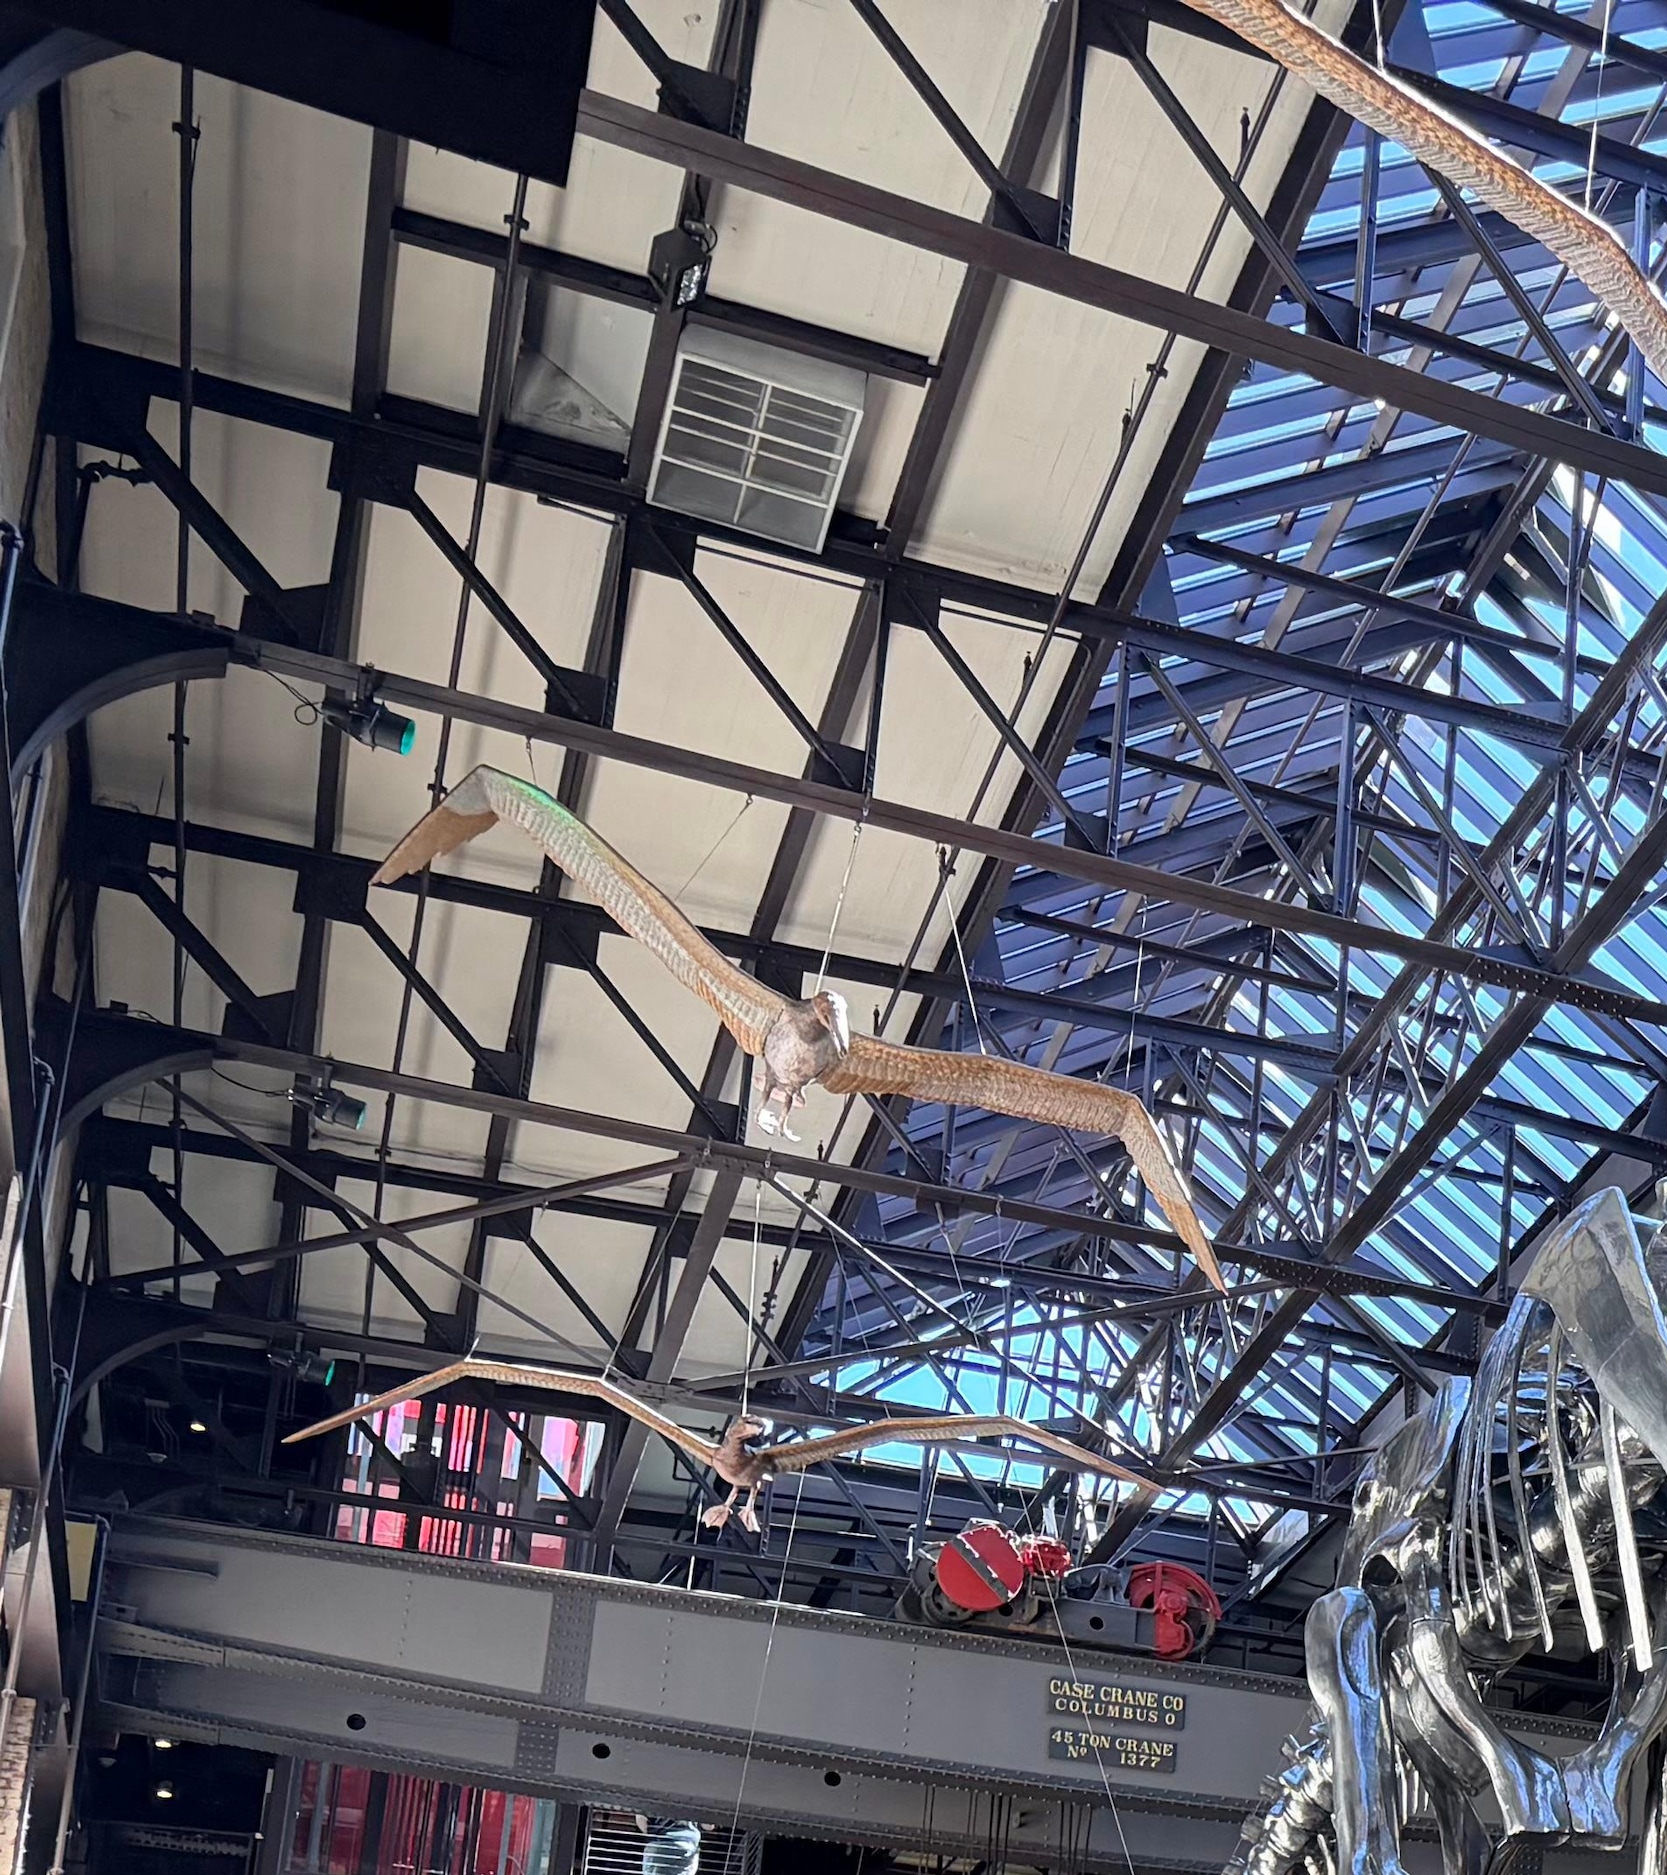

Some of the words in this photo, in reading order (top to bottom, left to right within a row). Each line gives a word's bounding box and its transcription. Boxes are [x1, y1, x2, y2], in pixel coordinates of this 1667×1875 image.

[1050, 1679, 1095, 1699] CASE
[1100, 1686, 1158, 1708] CRANE
[1163, 1694, 1184, 1711] CO
[1055, 1697, 1159, 1723] COLUMBUS
[1052, 1729, 1074, 1743] 45
[1078, 1732, 1111, 1749] TON
[1115, 1737, 1174, 1757] CRANE
[1120, 1752, 1161, 1768] 1377
